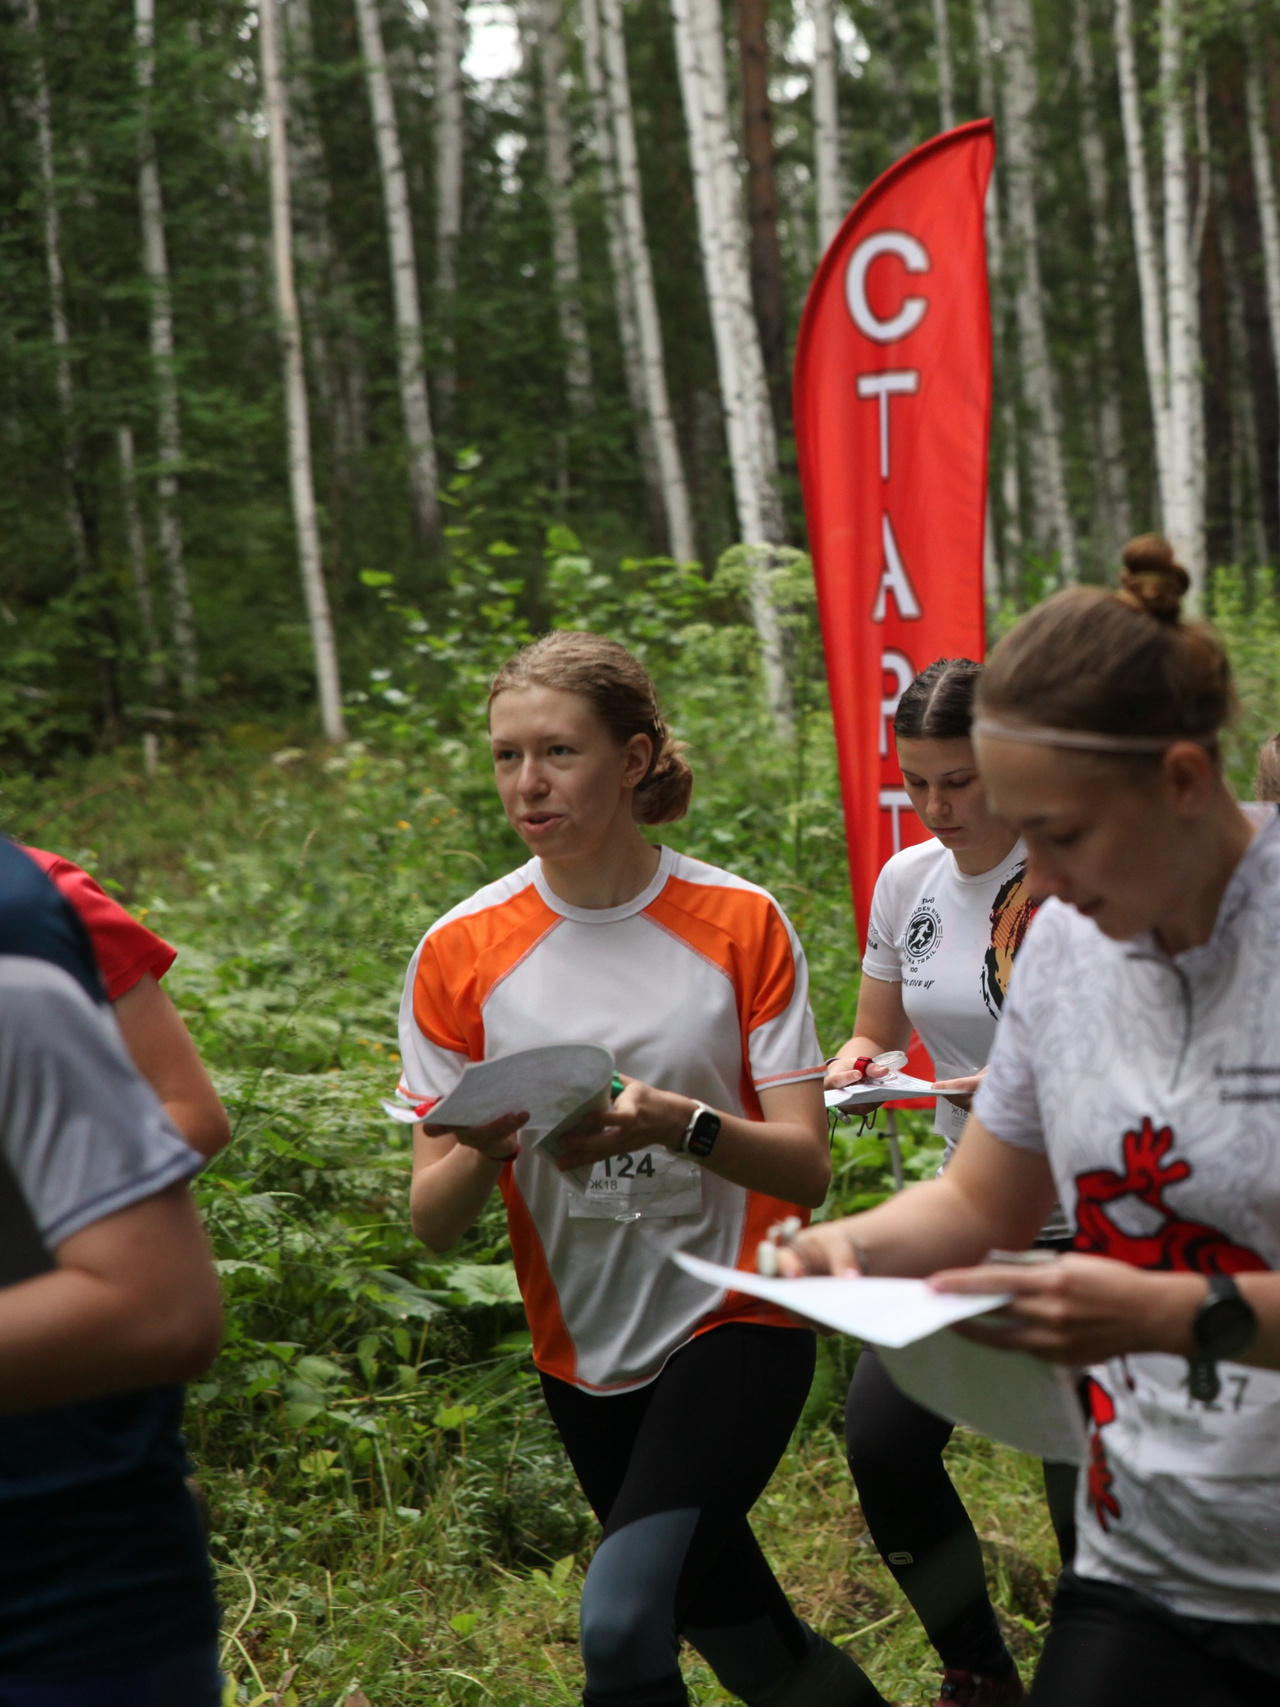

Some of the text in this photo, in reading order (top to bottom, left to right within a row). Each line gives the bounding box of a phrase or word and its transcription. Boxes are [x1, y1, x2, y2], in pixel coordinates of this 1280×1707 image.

[845, 230, 930, 854] СТАРТ
[917, 950, 937, 965] TRAIL
[604, 1152, 656, 1179] 124
[590, 1179, 618, 1190] Ж18
